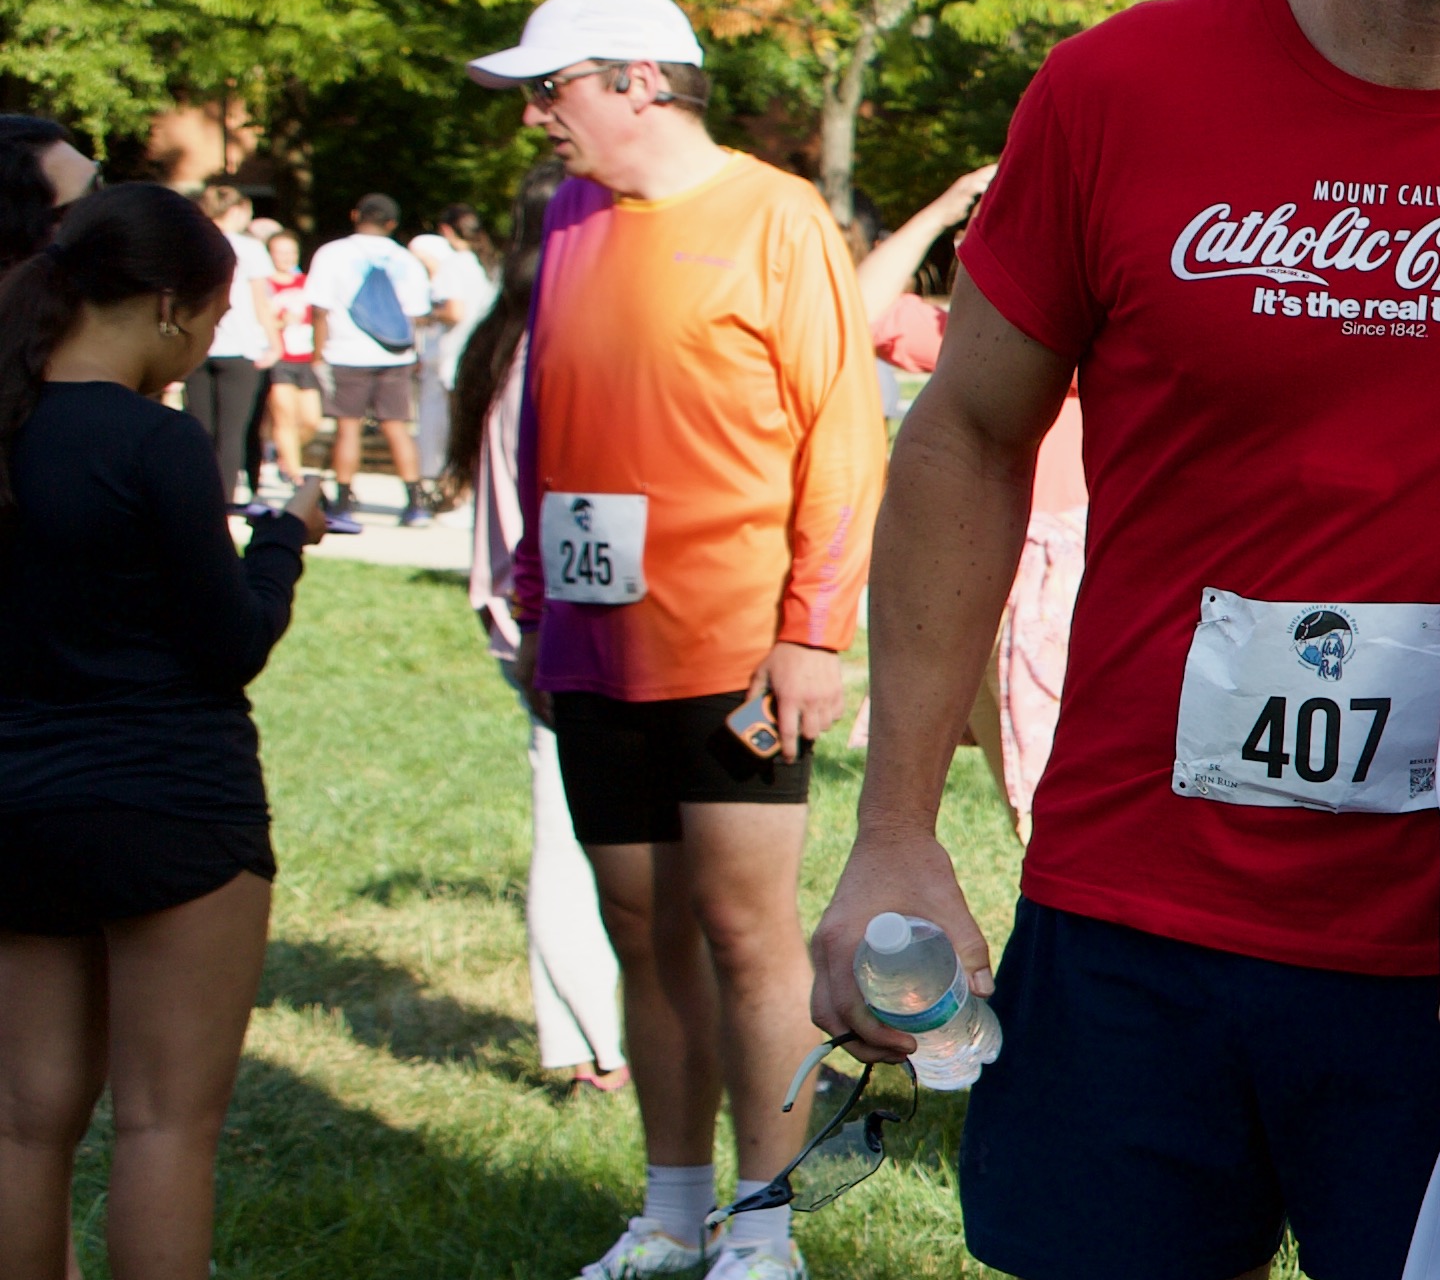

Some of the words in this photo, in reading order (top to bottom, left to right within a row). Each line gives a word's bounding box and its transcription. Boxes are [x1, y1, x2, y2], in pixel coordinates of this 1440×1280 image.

[1313, 179, 1389, 206] MOUNT
[1252, 287, 1302, 315] It's
[1305, 291, 1361, 319] the
[1363, 295, 1428, 322] real
[1341, 321, 1386, 336] Since
[560, 540, 613, 586] 245
[1242, 696, 1391, 783] 407
[1217, 777, 1238, 789] RUN
